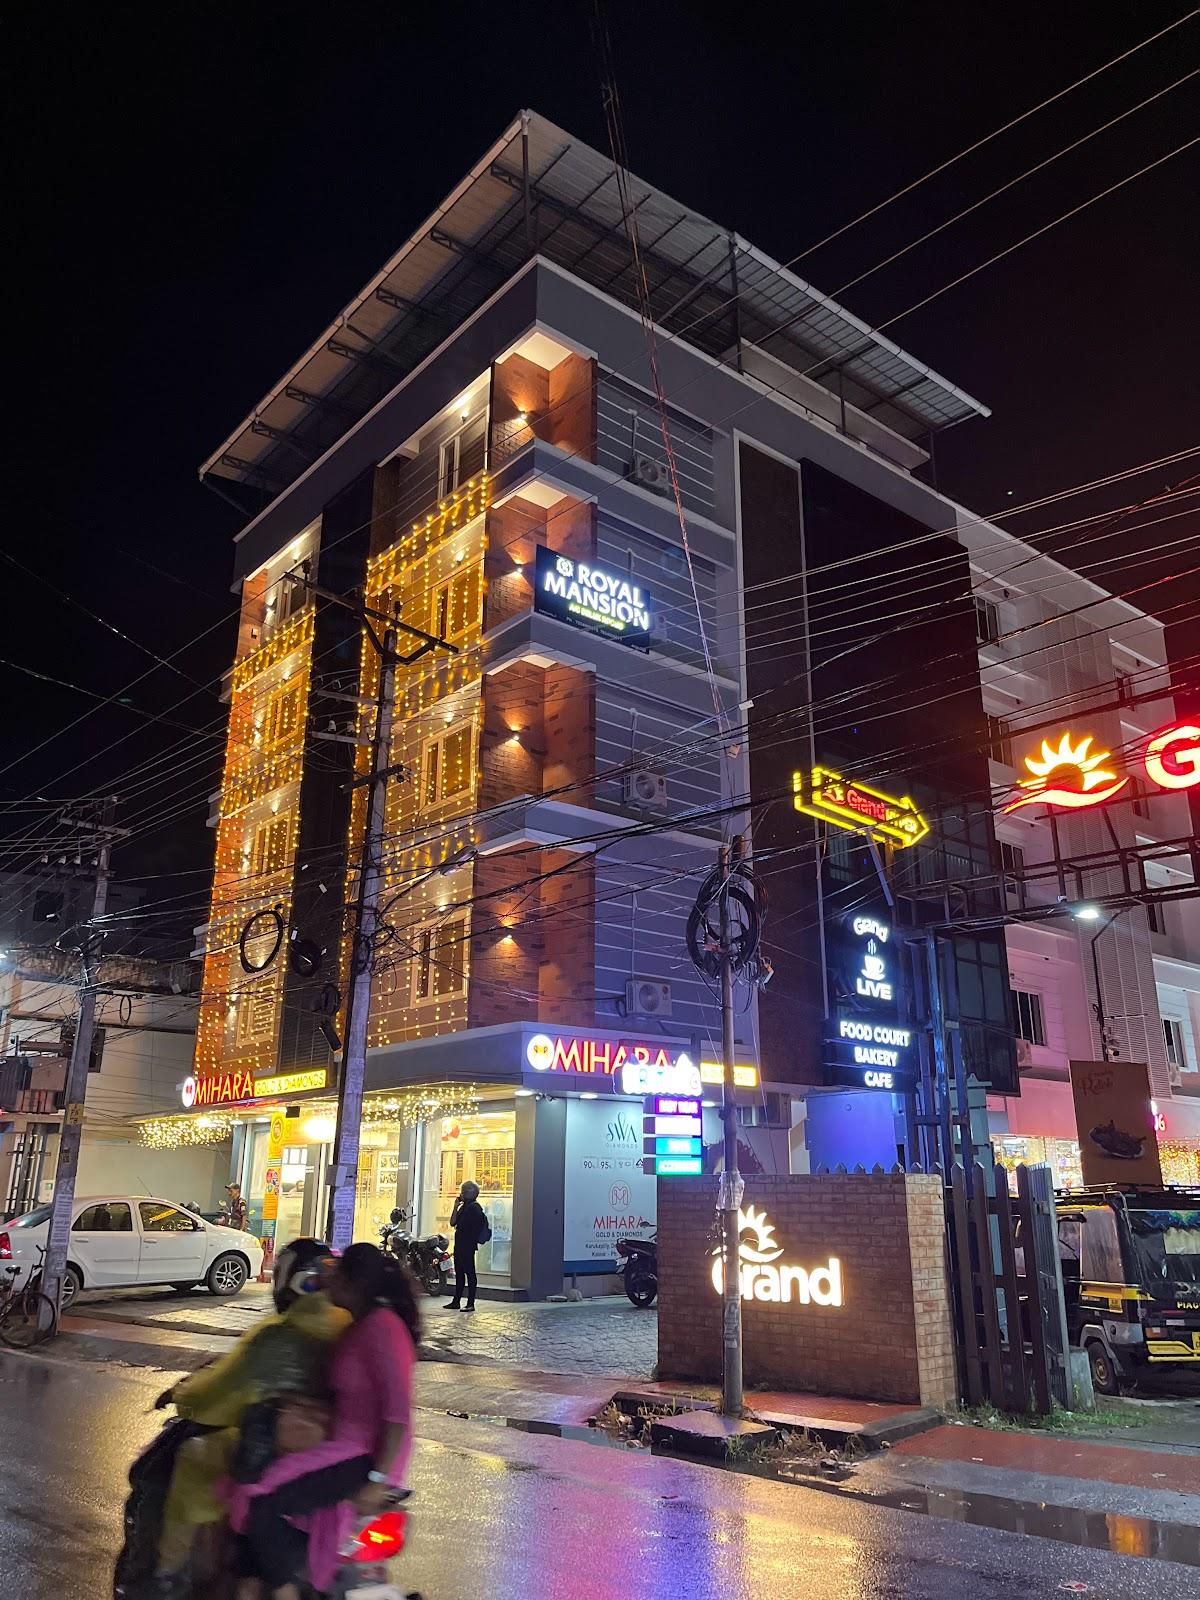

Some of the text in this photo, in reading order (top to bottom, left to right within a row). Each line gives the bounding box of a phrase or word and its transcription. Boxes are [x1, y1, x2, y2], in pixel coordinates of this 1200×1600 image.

[578, 564, 645, 609] ROYAL
[544, 572, 649, 631] MANSION
[853, 916, 889, 943] Grand
[856, 978, 892, 1001] LIVE
[840, 1021, 910, 1047] FOOD COURT
[854, 1046, 898, 1067] BAKERY
[194, 1072, 254, 1105] MIHARA
[864, 1070, 893, 1089] CAFE
[593, 1215, 645, 1229] MIHARA
